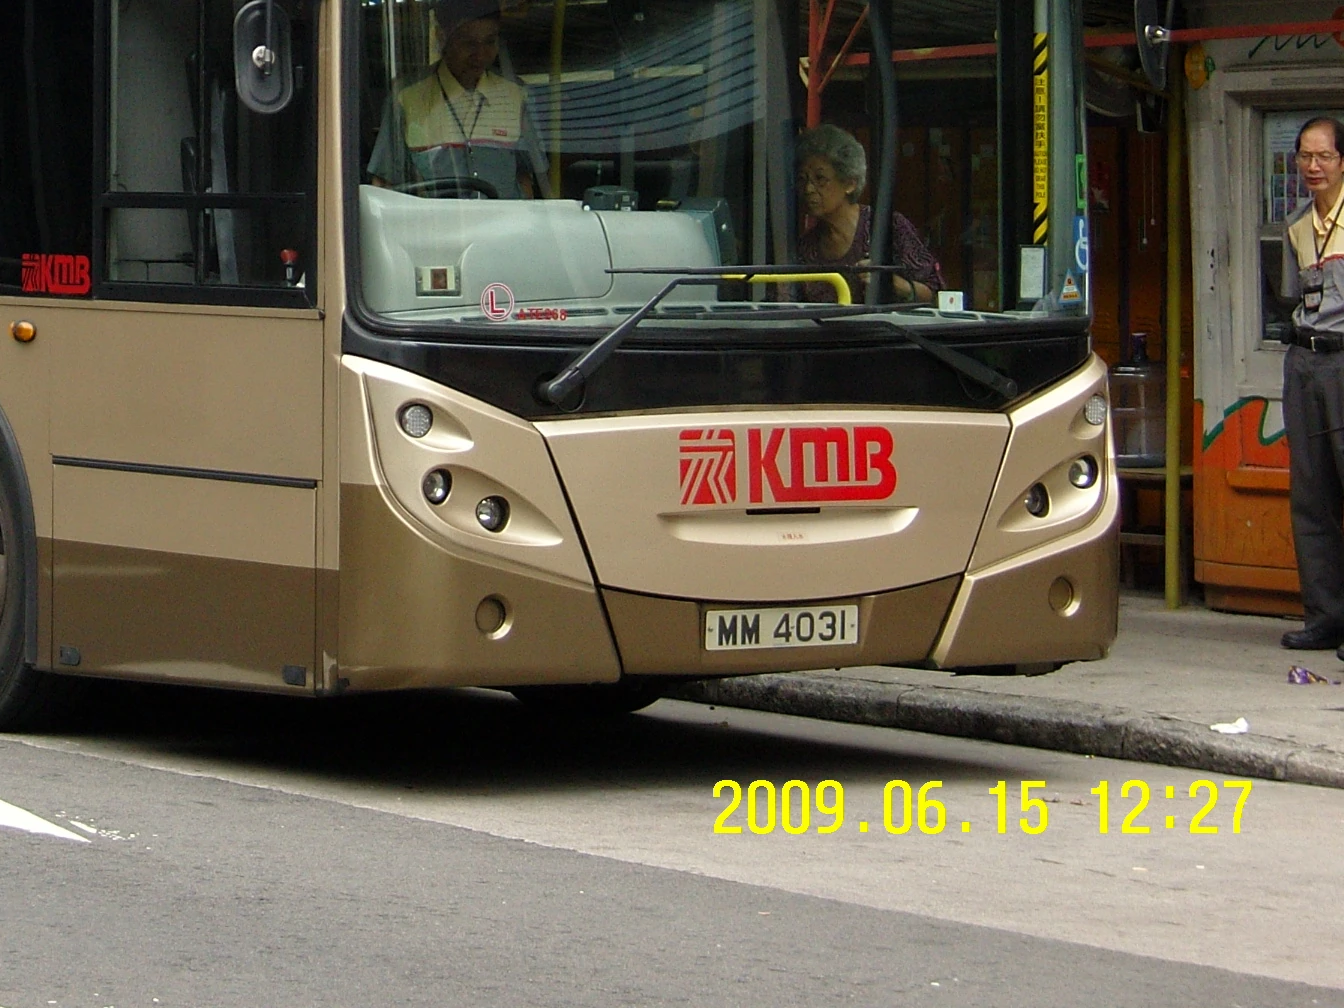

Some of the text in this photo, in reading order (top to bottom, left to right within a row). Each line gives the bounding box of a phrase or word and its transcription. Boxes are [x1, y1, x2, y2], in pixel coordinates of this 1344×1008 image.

[39, 254, 92, 295] KMB
[489, 290, 506, 315] L
[748, 426, 897, 503] KMB
[717, 609, 846, 646] MM 4031
